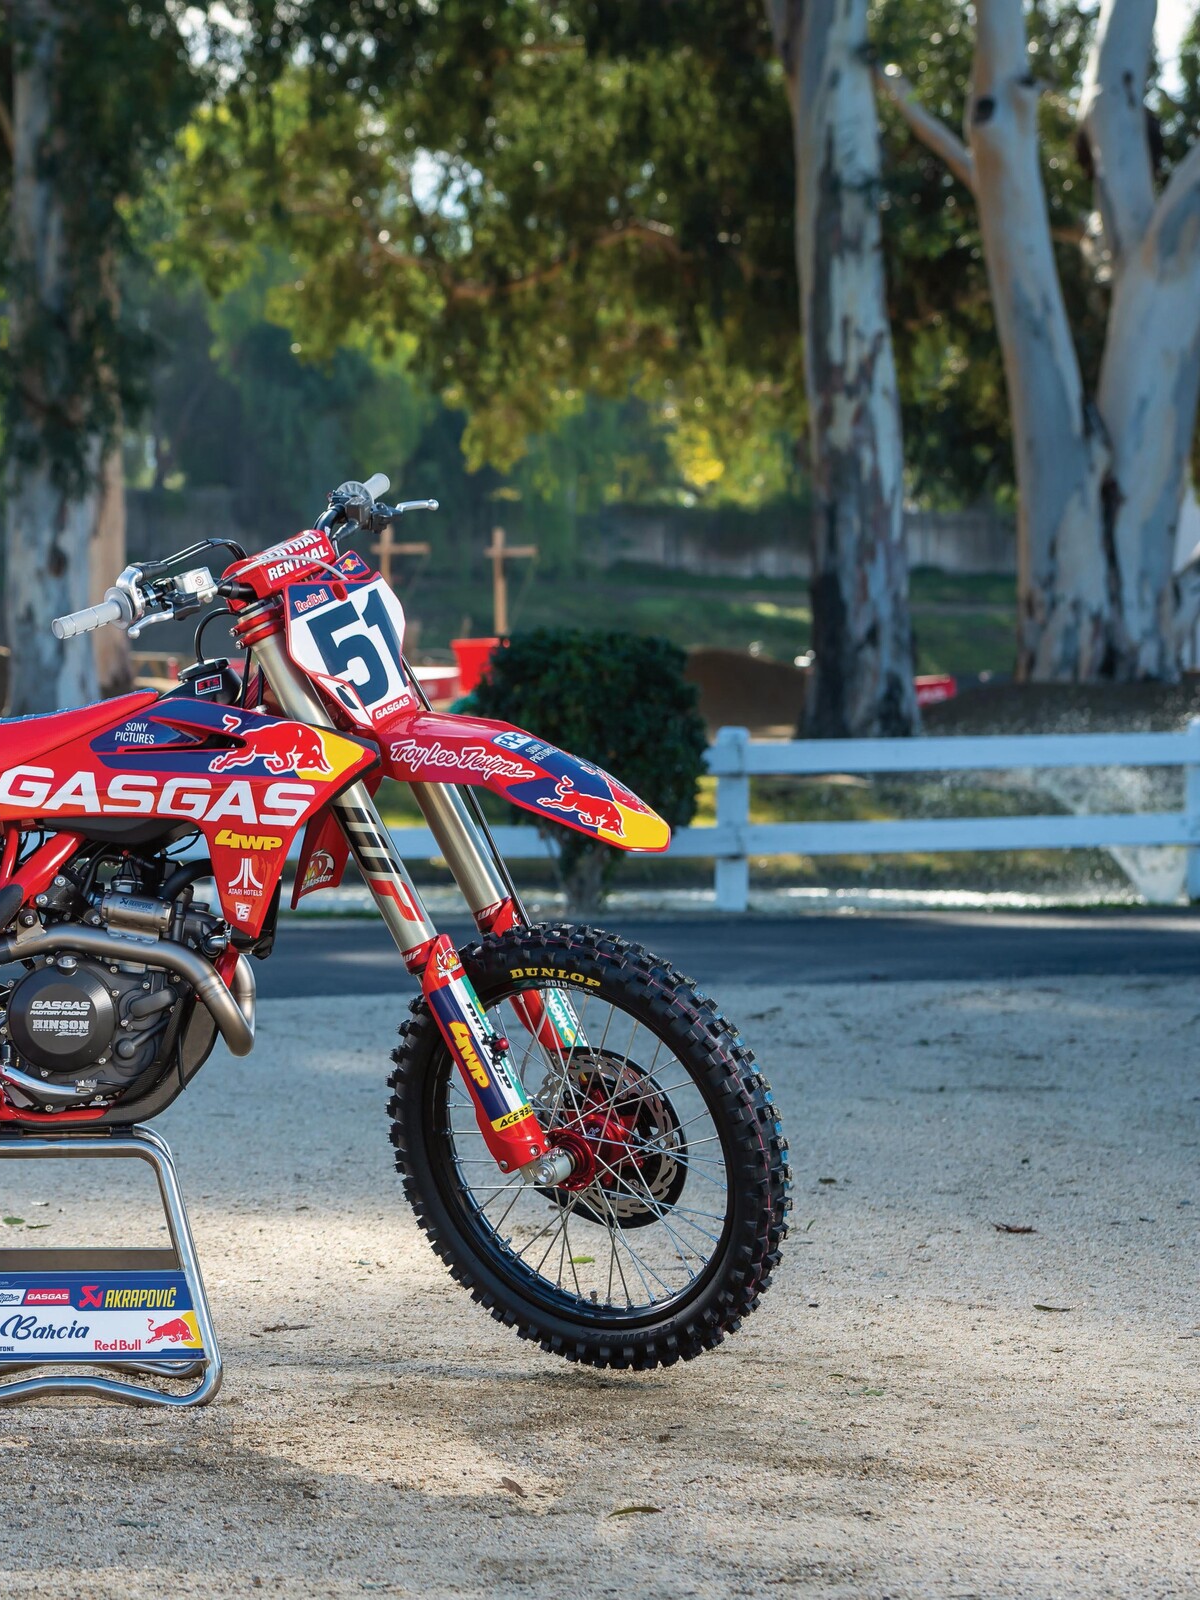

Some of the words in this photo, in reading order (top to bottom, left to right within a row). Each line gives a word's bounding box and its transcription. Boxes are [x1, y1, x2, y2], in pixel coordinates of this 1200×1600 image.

[267, 545, 330, 581] RENTHAL
[294, 597, 315, 613] Red
[310, 588, 330, 605] Bull
[306, 588, 408, 710] 51
[197, 677, 220, 690] ETS
[375, 696, 410, 720] GASGAS
[125, 722, 149, 732] SONY
[114, 731, 155, 744] PICTURES
[390, 739, 427, 772] Troy
[425, 742, 458, 768] Lee
[455, 747, 536, 780] Designs
[244, 888, 263, 896] HOTELS
[510, 968, 601, 988] DUNLOP
[32, 1000, 90, 1010] GASGAS
[32, 1020, 90, 1030] HINSON
[104, 1287, 177, 1308] AKRAPOVIČ
[0, 1314, 90, 1340] Barcia
[94, 1340, 118, 1350] Red
[120, 1339, 142, 1350] Bull
